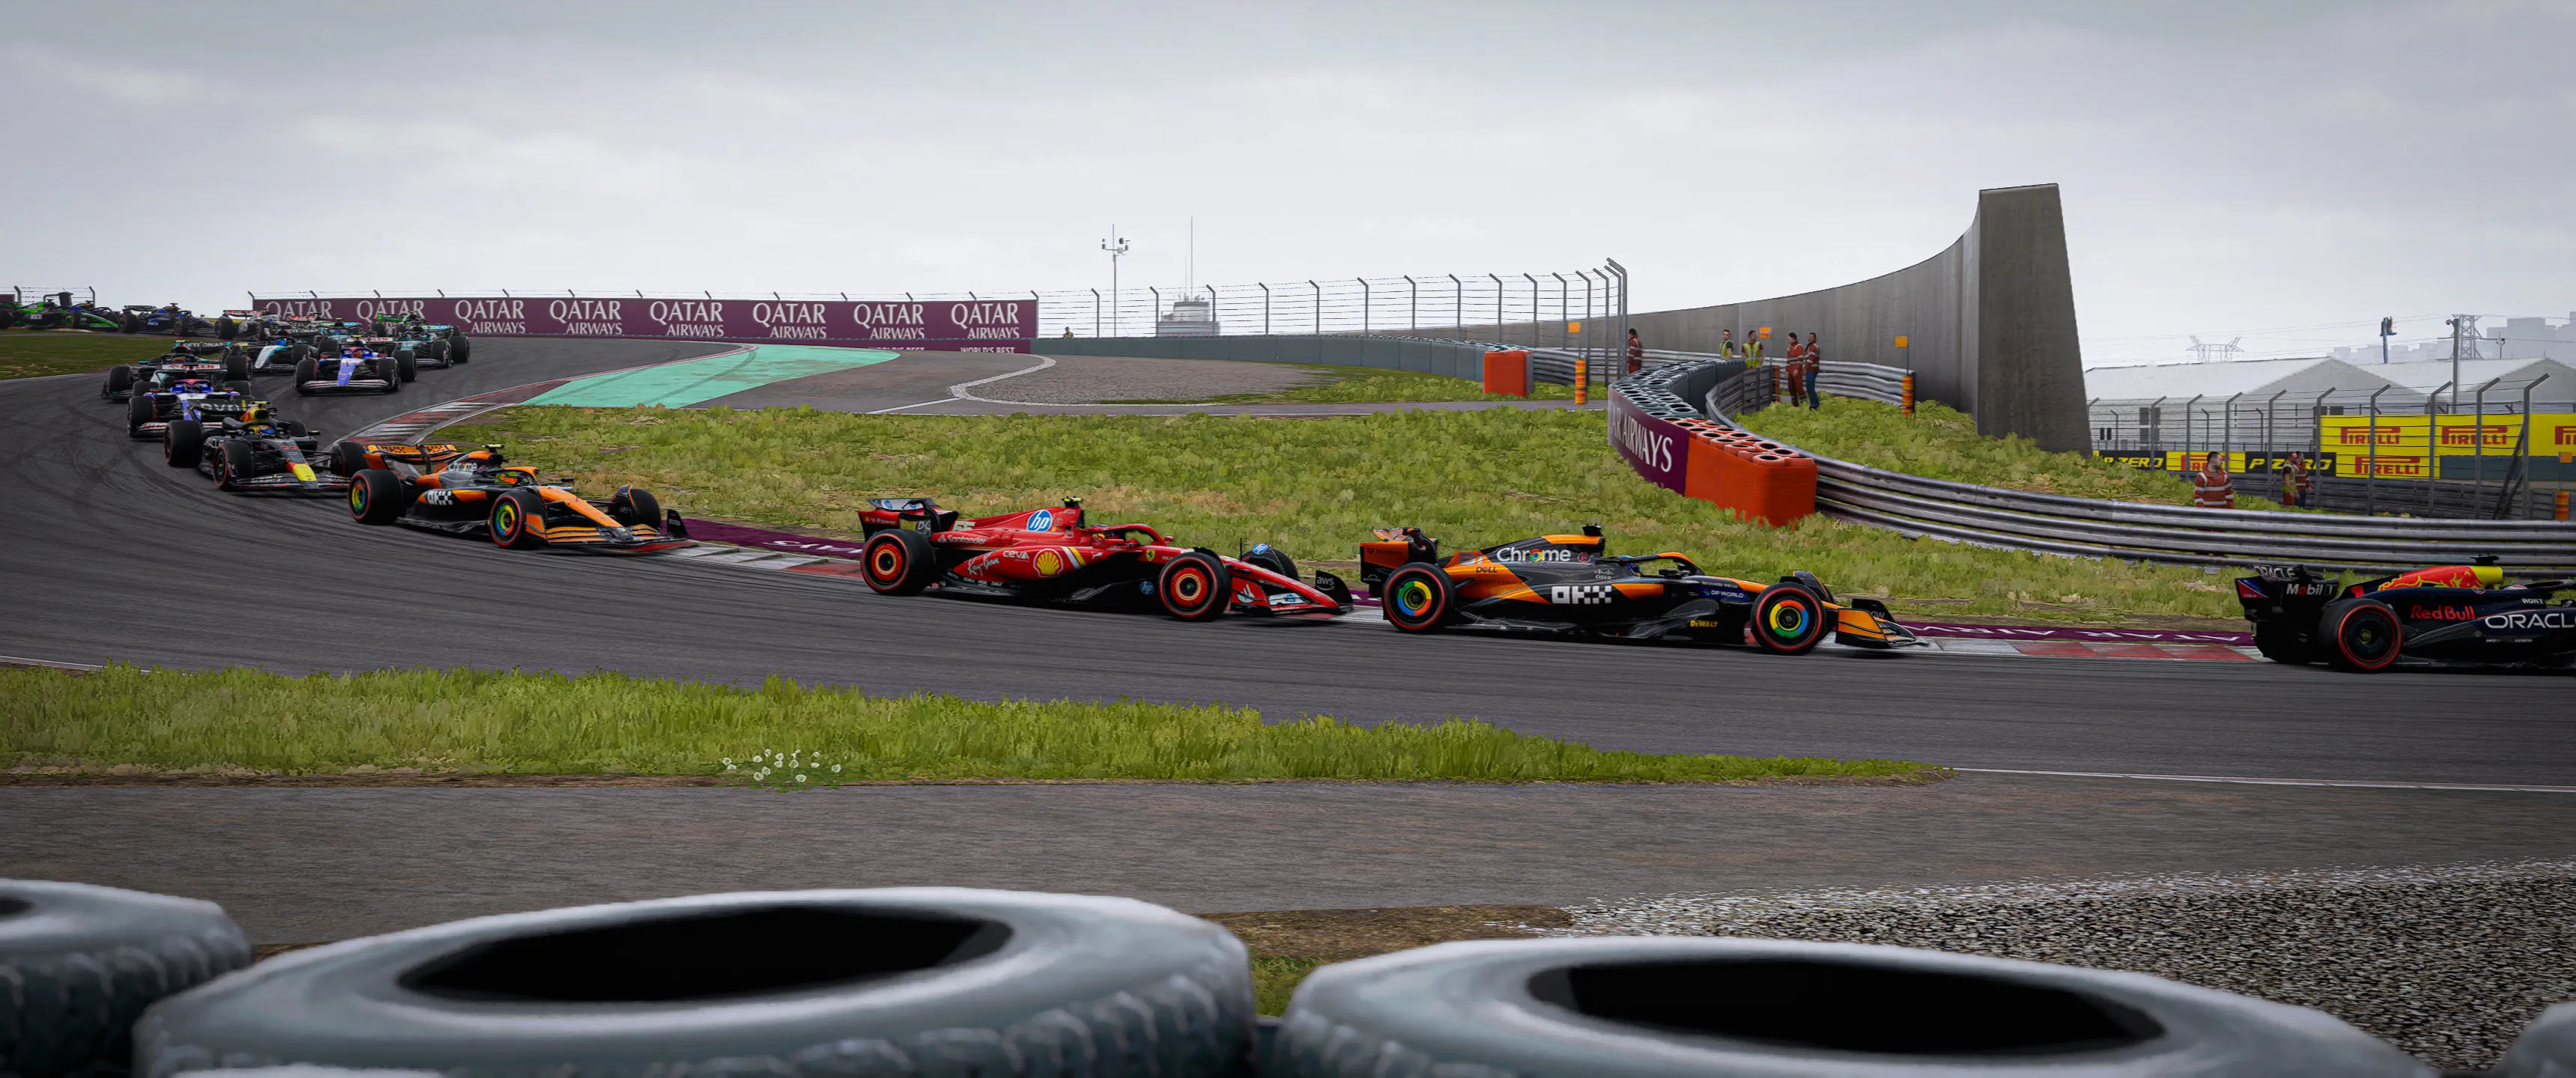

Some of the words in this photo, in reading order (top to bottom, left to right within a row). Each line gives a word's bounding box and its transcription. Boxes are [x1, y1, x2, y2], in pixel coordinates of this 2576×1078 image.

[266, 301, 333, 320] QATAR
[356, 300, 425, 323] QATAR
[455, 300, 525, 323] QATAR
[549, 300, 622, 324] QATAR
[649, 301, 723, 325] QATAR
[753, 302, 826, 328] QATAR
[854, 303, 925, 329] QATAR
[951, 303, 1019, 329] QATAR
[471, 322, 526, 334] AIRWAYS
[565, 322, 623, 335] AIRWAYS
[666, 324, 725, 337] AIRWAYS
[770, 326, 827, 338] AIRWAYS
[869, 327, 926, 339] AIRWAYS
[967, 327, 1020, 339] AIRWAYS
[1621, 412, 1673, 472] AIRWAYS
[2249, 458, 2265, 469] P
[2271, 458, 2333, 470] ZRO
[2355, 456, 2420, 475] PIRELLI
[1028, 509, 1051, 532] hp
[947, 535, 986, 544] Santander
[1496, 546, 1572, 561] Chrome
[1141, 581, 1153, 594] hp
[1316, 576, 1334, 585] aws
[1552, 585, 1612, 604] OKX
[2286, 583, 2324, 595] Mobil
[2411, 604, 2443, 620] Red
[2443, 605, 2475, 621] Bull
[2485, 613, 2576, 628] ORACL
